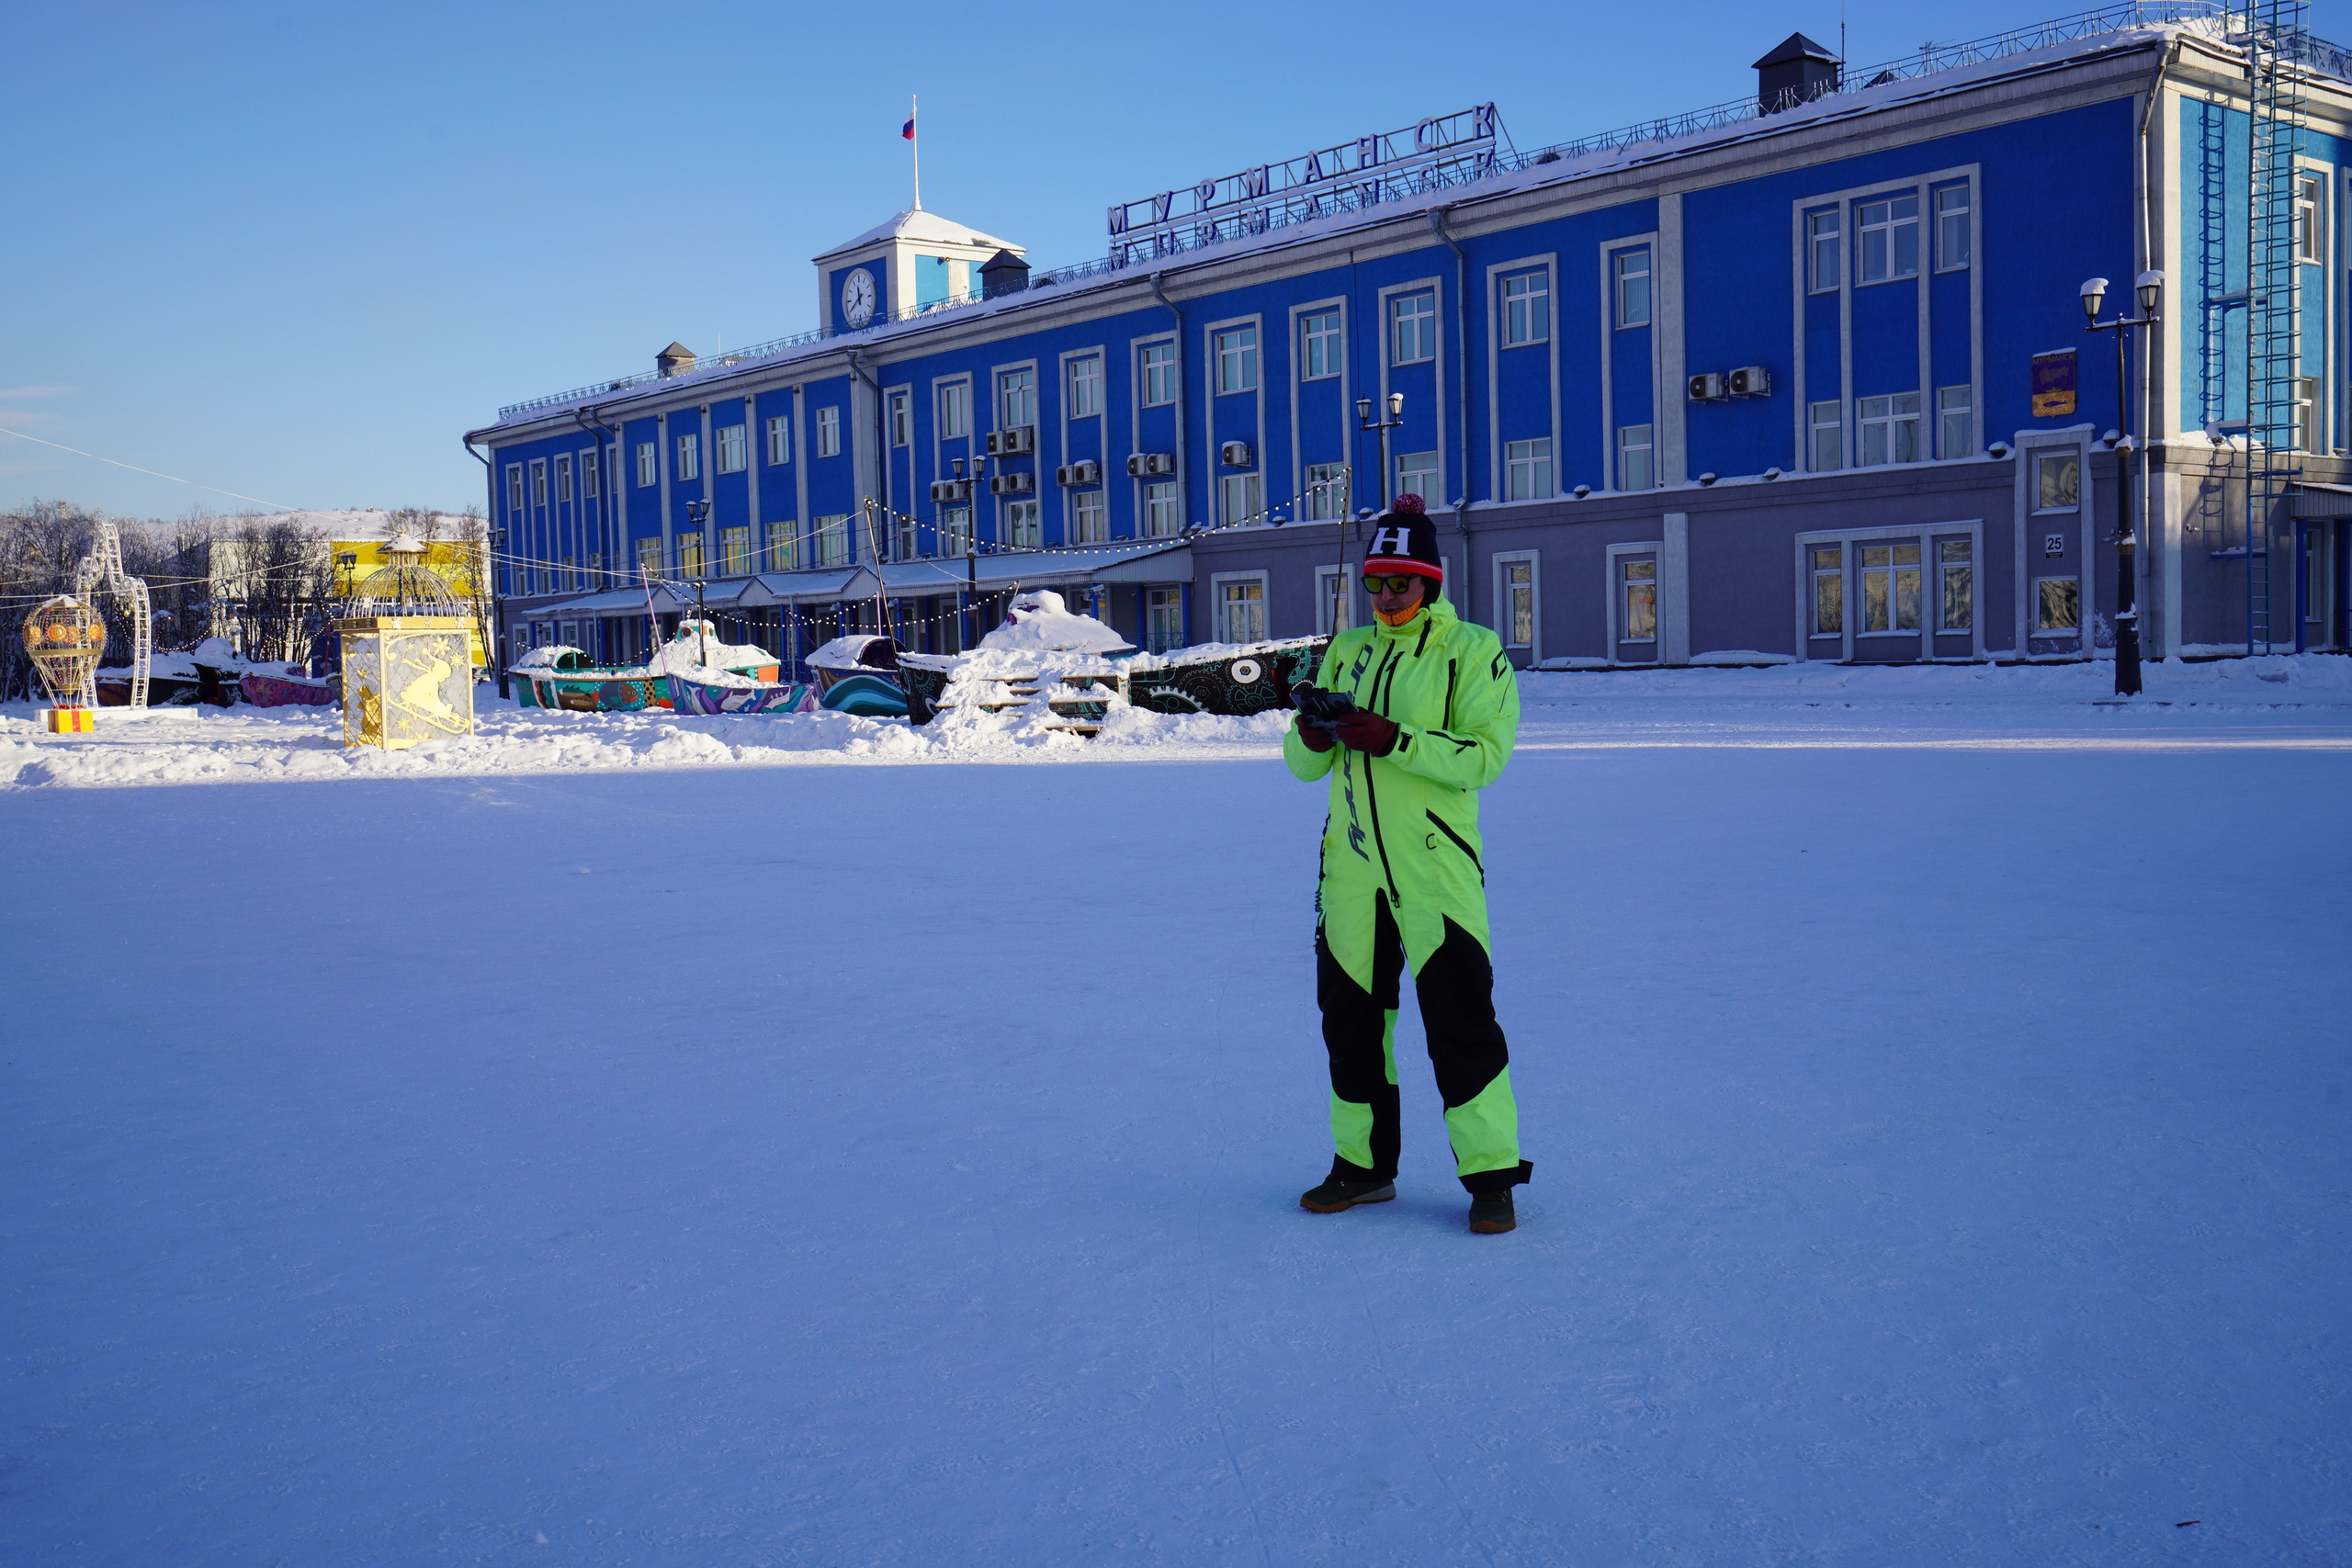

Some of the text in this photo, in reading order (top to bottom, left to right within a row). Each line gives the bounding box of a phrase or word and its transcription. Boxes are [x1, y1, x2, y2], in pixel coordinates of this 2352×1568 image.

[1106, 101, 1495, 235] МУРМАНСК
[2032, 353, 2075, 366] МУРМАНСК
[1369, 526, 1411, 556] H
[2047, 536, 2062, 550] 25
